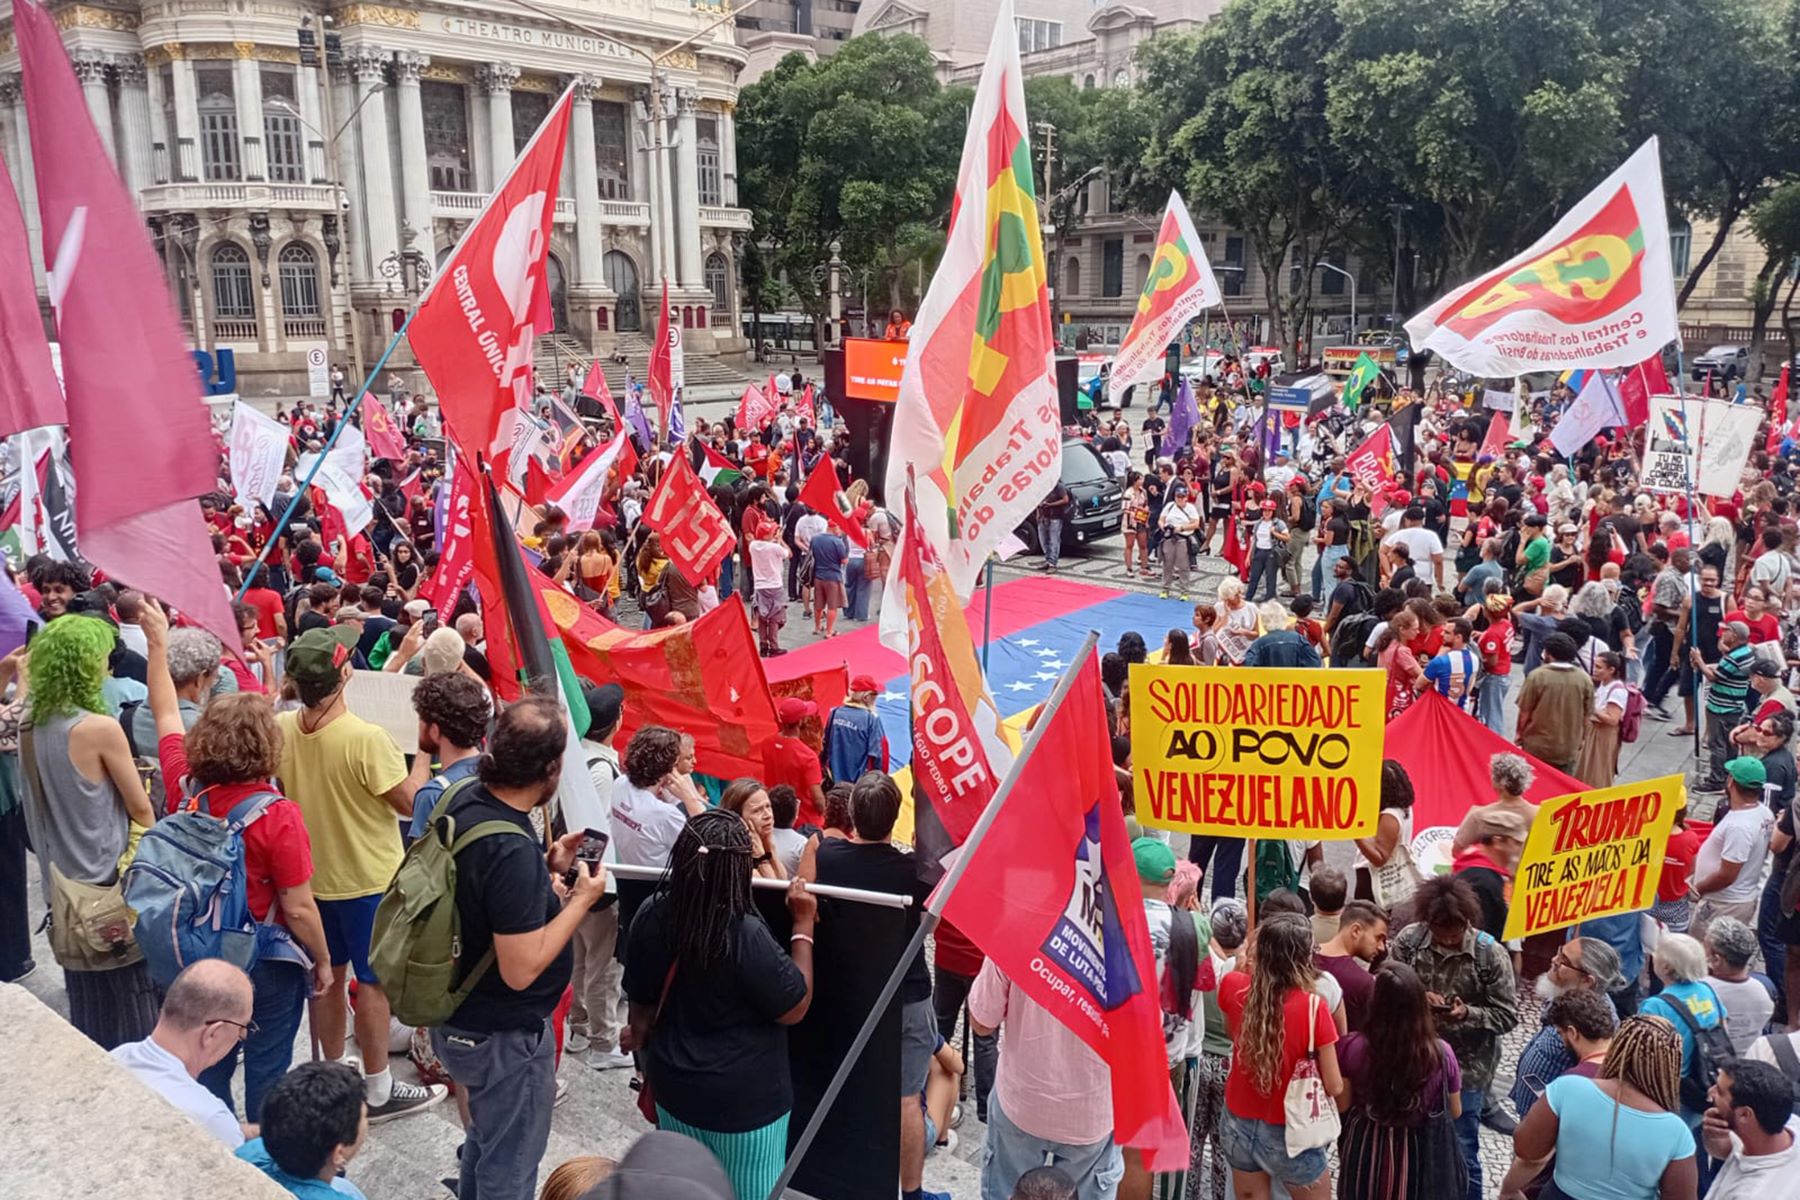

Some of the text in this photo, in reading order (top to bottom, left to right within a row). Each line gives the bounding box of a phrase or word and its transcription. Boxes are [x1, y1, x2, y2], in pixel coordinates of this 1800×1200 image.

[456, 19, 625, 56] THEATRO MUNICIPAL
[453, 264, 504, 381] CENTRAL ÚNIC
[1642, 477, 1656, 486] LOS
[1658, 454, 1682, 464] TU NO
[1149, 678, 1362, 728] SOLIDARIEDADE
[913, 728, 953, 804] ÉGIO PEDRO II
[1165, 728, 1350, 769] AO POVO
[1143, 768, 1365, 830] VENEZUELANO.
[1550, 791, 1662, 855] TRUMP
[1525, 861, 1556, 890] TIRE
[1559, 855, 1581, 884] AS
[1631, 837, 1651, 866] DA
[1029, 957, 1076, 1004] Ocupar,
[1049, 935, 1069, 957] DE
[1068, 950, 1096, 983] LUTA
